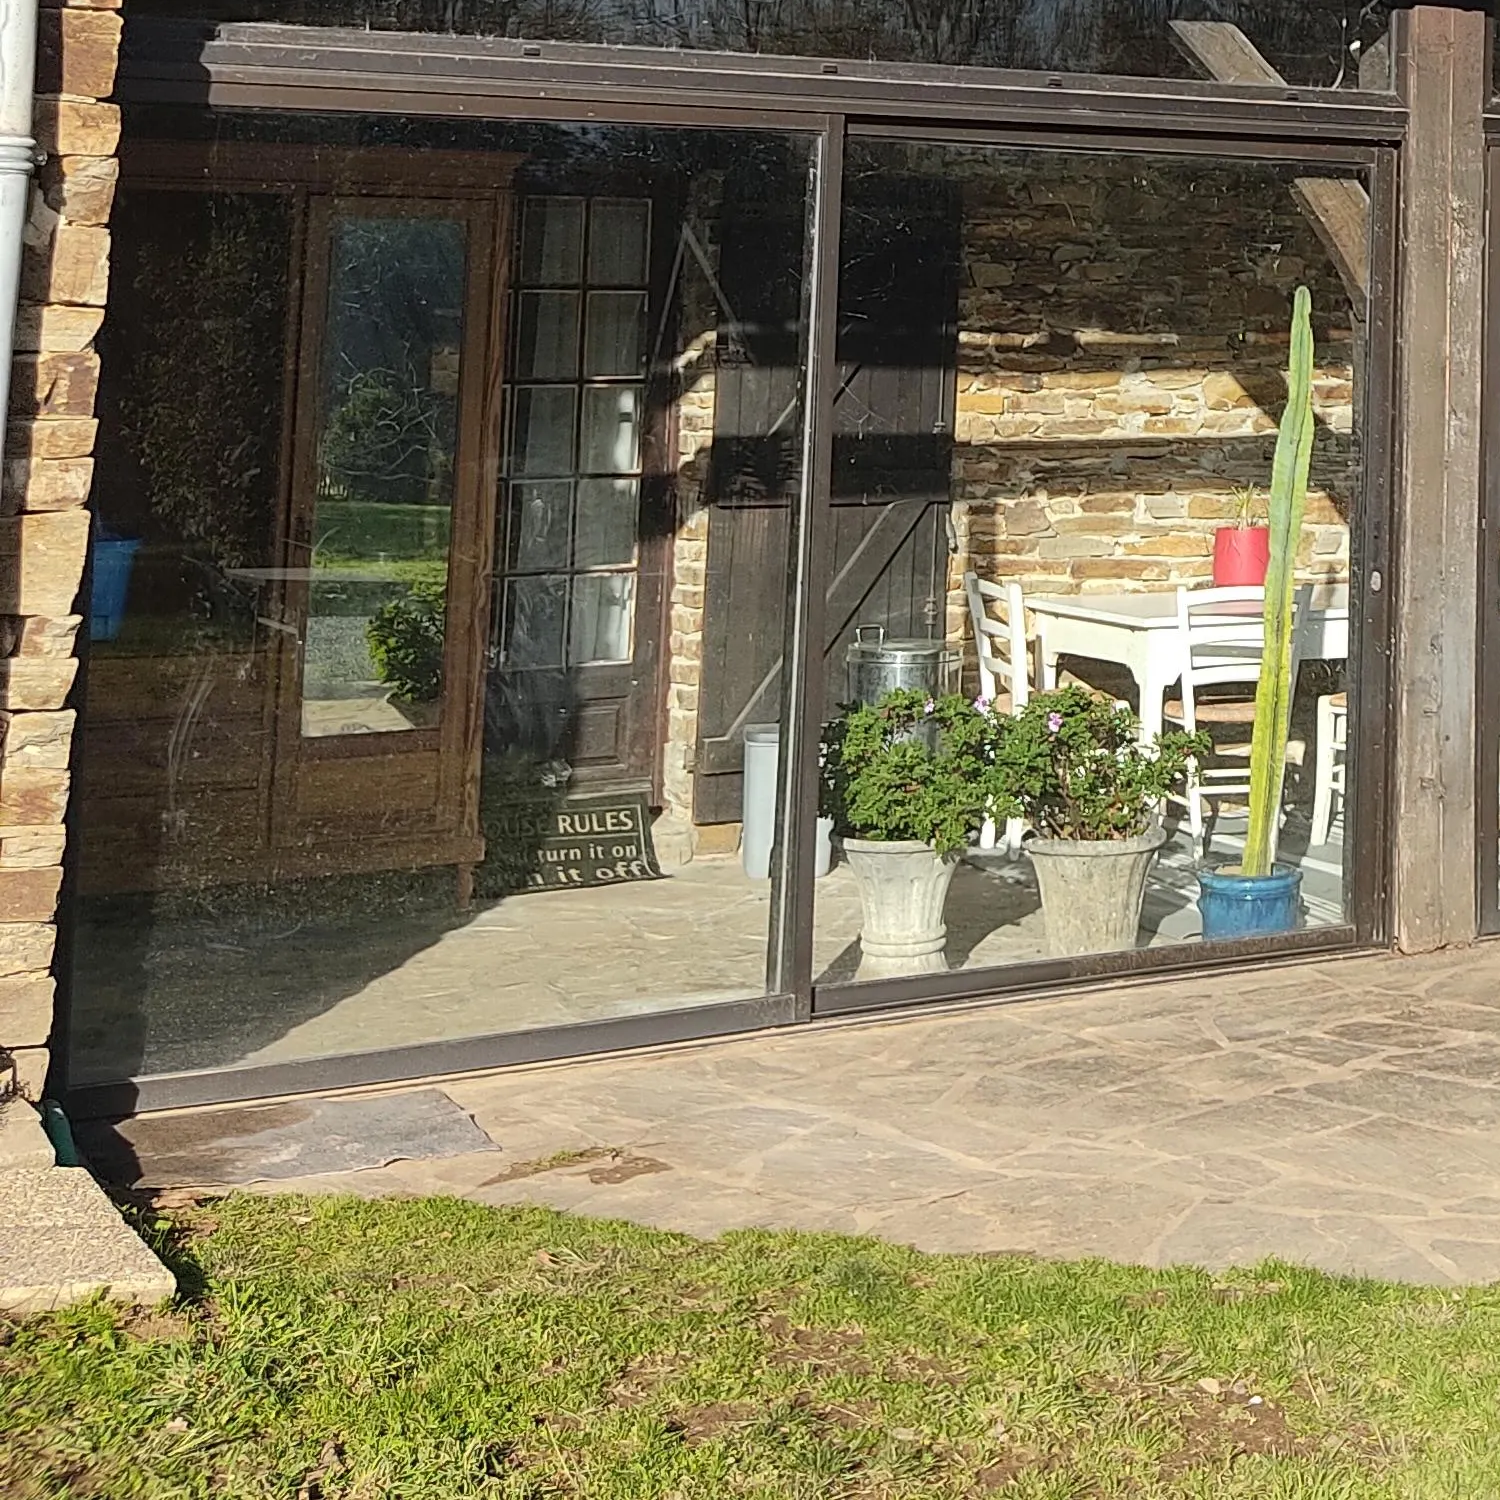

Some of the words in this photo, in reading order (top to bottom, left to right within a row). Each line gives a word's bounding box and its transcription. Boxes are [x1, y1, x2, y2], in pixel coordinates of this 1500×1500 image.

[484, 813, 550, 839] OUSE
[557, 810, 634, 834] RULES
[538, 846, 581, 863] turn
[589, 843, 604, 860] it
[612, 844, 638, 858] on
[557, 865, 584, 884] it
[595, 860, 644, 879] off
